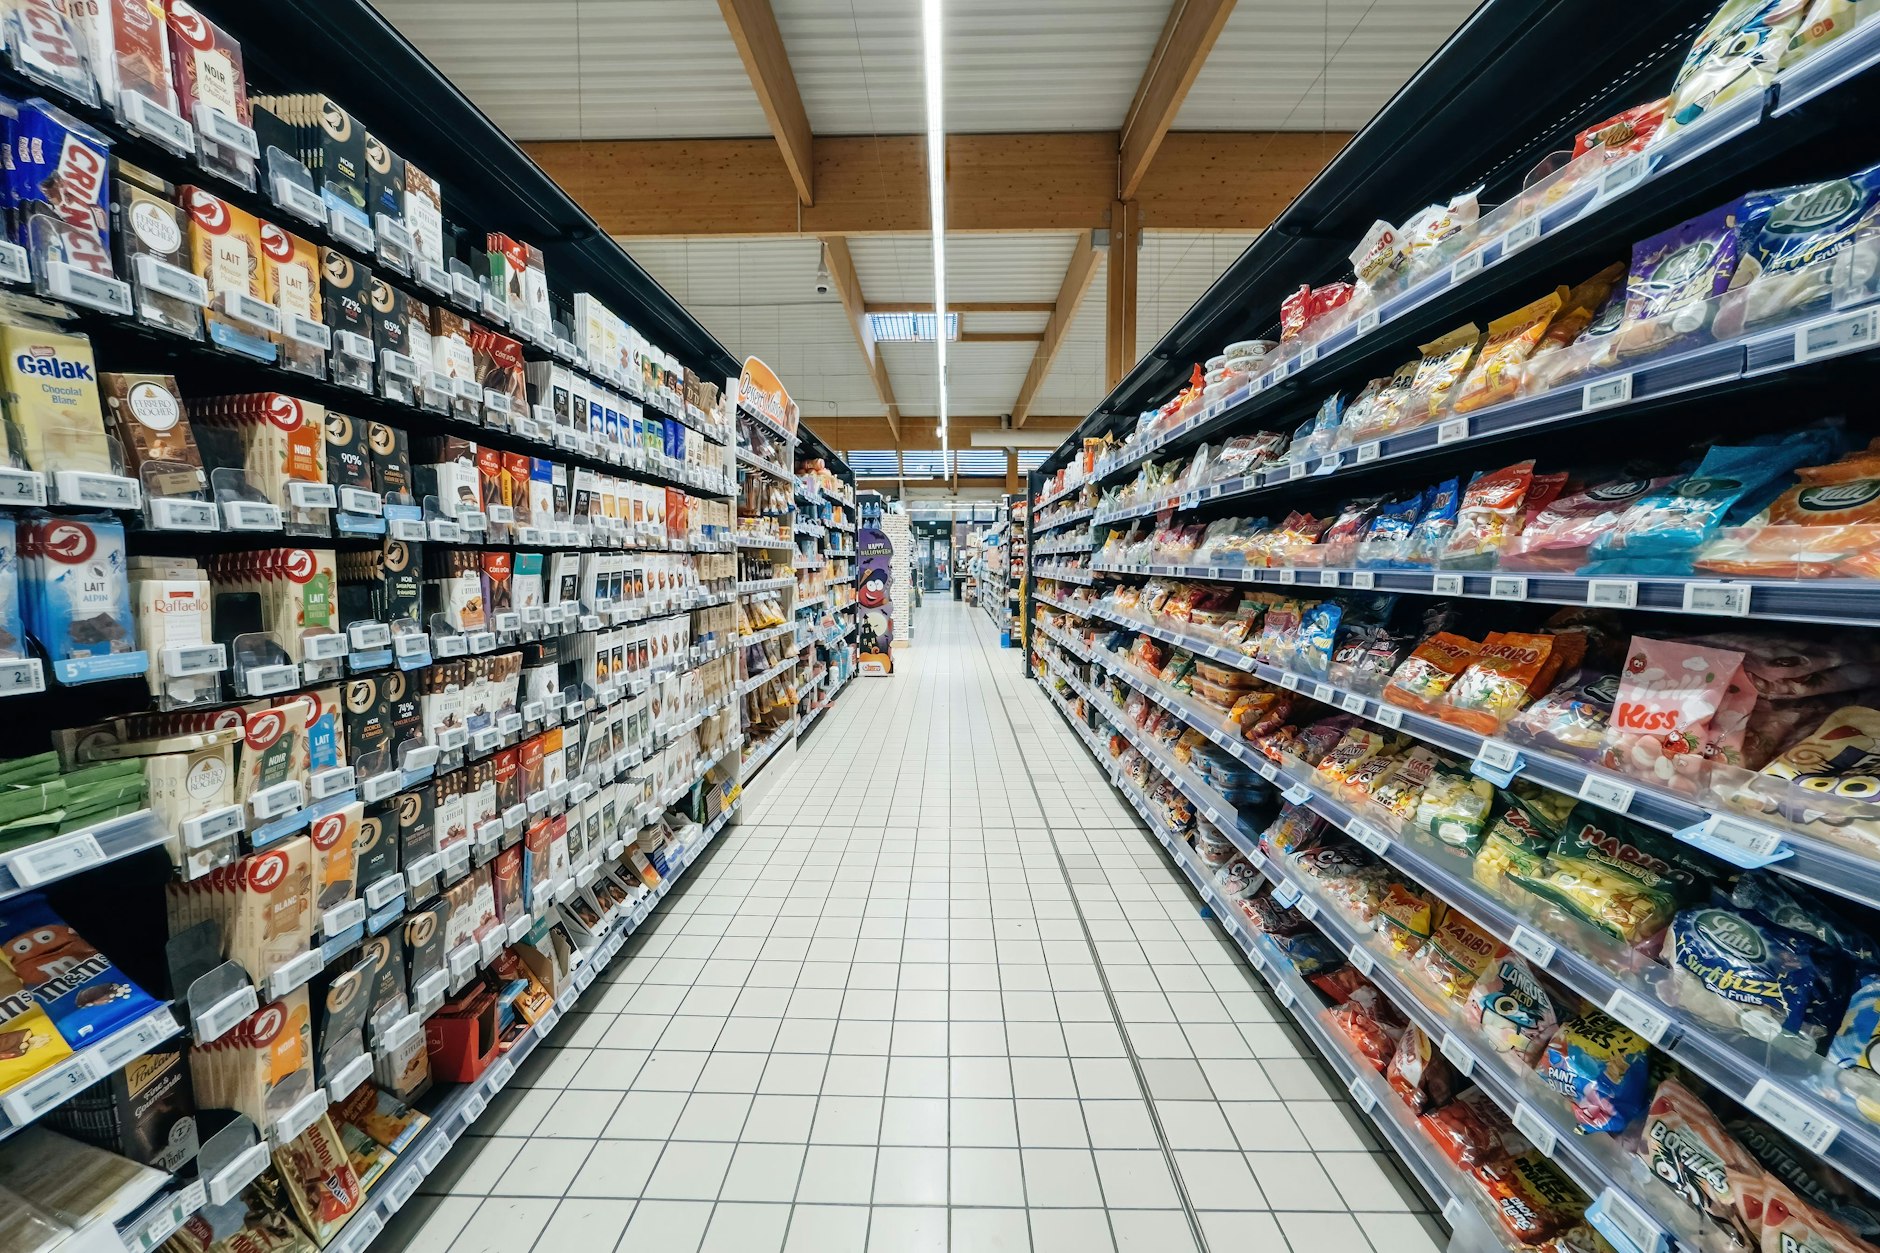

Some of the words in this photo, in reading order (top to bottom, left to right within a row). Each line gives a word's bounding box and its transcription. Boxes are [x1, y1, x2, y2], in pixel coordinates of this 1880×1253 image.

[203, 61, 226, 85] NOIR
[339, 156, 355, 170] NOIR
[62, 144, 113, 278] CRUNCH
[1771, 190, 1847, 229] Lutti
[136, 213, 176, 237] FERRERO
[136, 221, 175, 245] ROCHER
[220, 248, 241, 267] LAIT
[1814, 239, 1853, 263] Fruits
[286, 275, 303, 291] LAIT
[341, 295, 363, 315] 72%
[384, 319, 403, 336] 85%
[17, 353, 94, 382] Galak
[41, 383, 83, 397] Chocolat
[51, 395, 78, 406] Blanc
[134, 399, 172, 409] FERRERO
[137, 407, 175, 417] ROCHER
[294, 443, 312, 457] NOIR
[341, 452, 363, 467] 90%
[867, 542, 884, 550] HAPPY
[84, 582, 105, 592] LAIT
[83, 593, 109, 603] ALPIN
[154, 599, 209, 614] Raffaello
[309, 593, 325, 604] LAIT
[1480, 643, 1540, 665] HARIBO
[398, 702, 415, 714] 74%
[314, 733, 330, 745] LAIT
[268, 752, 287, 767] NOIR
[190, 767, 224, 785] FERRERO
[190, 775, 224, 791] ROCHER
[274, 894, 297, 914] BLANC
[1444, 921, 1494, 960] HARIBO
[1727, 989, 1763, 1006] Fruits
[1548, 1066, 1577, 1084] PAINT
[135, 1073, 182, 1119] Gourmande
[143, 1083, 164, 1102] Fine
[306, 1124, 333, 1168] arabou
[326, 1175, 352, 1206] Daim
